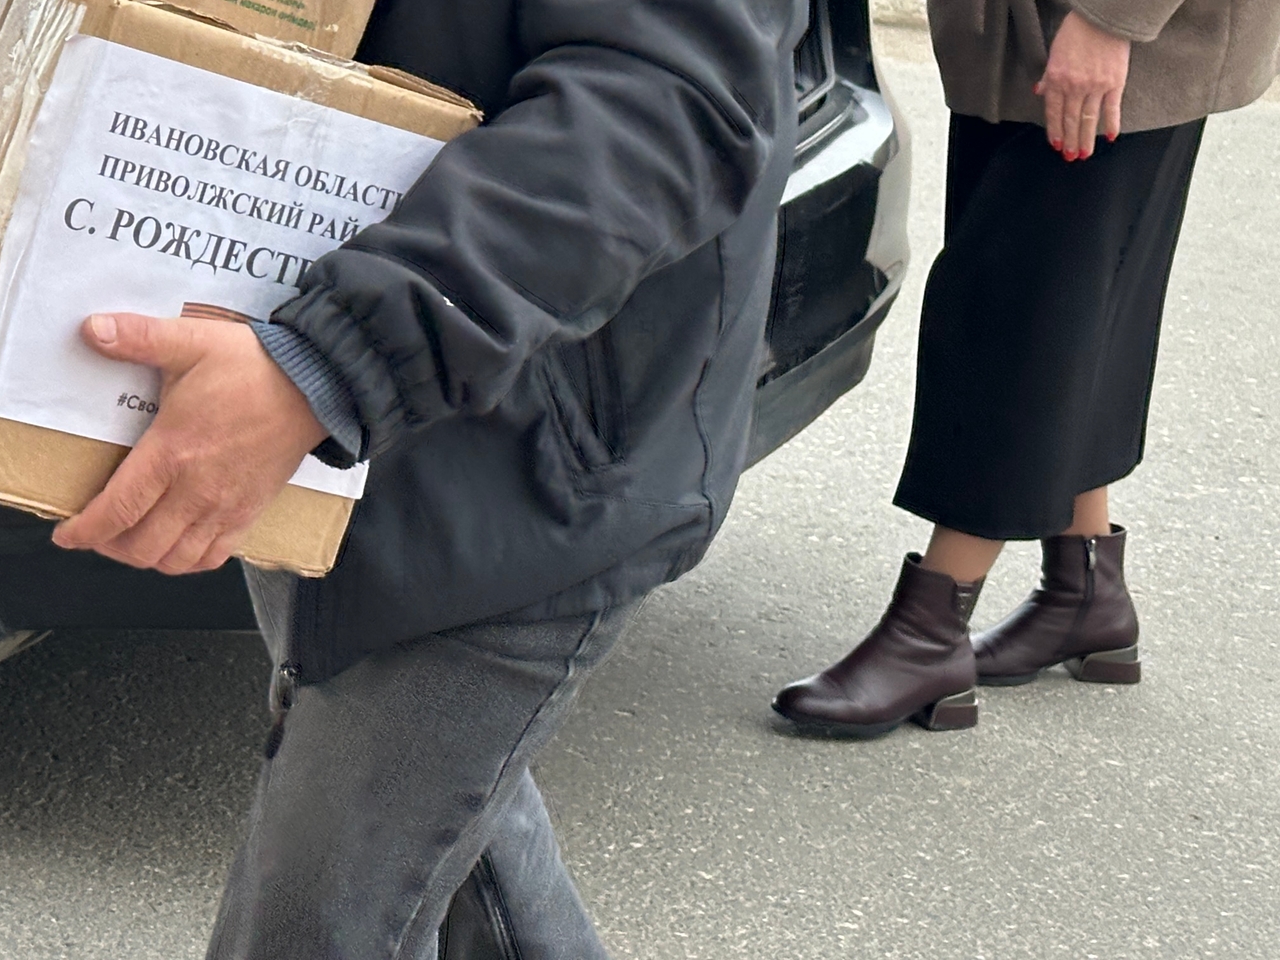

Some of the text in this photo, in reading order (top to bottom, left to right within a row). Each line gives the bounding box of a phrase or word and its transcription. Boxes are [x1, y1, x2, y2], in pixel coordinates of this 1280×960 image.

[108, 111, 293, 183] ИВАНОВСКАЯ
[64, 198, 96, 235] С.
[98, 154, 304, 230] ПРИВОЛЖСКИЙ
